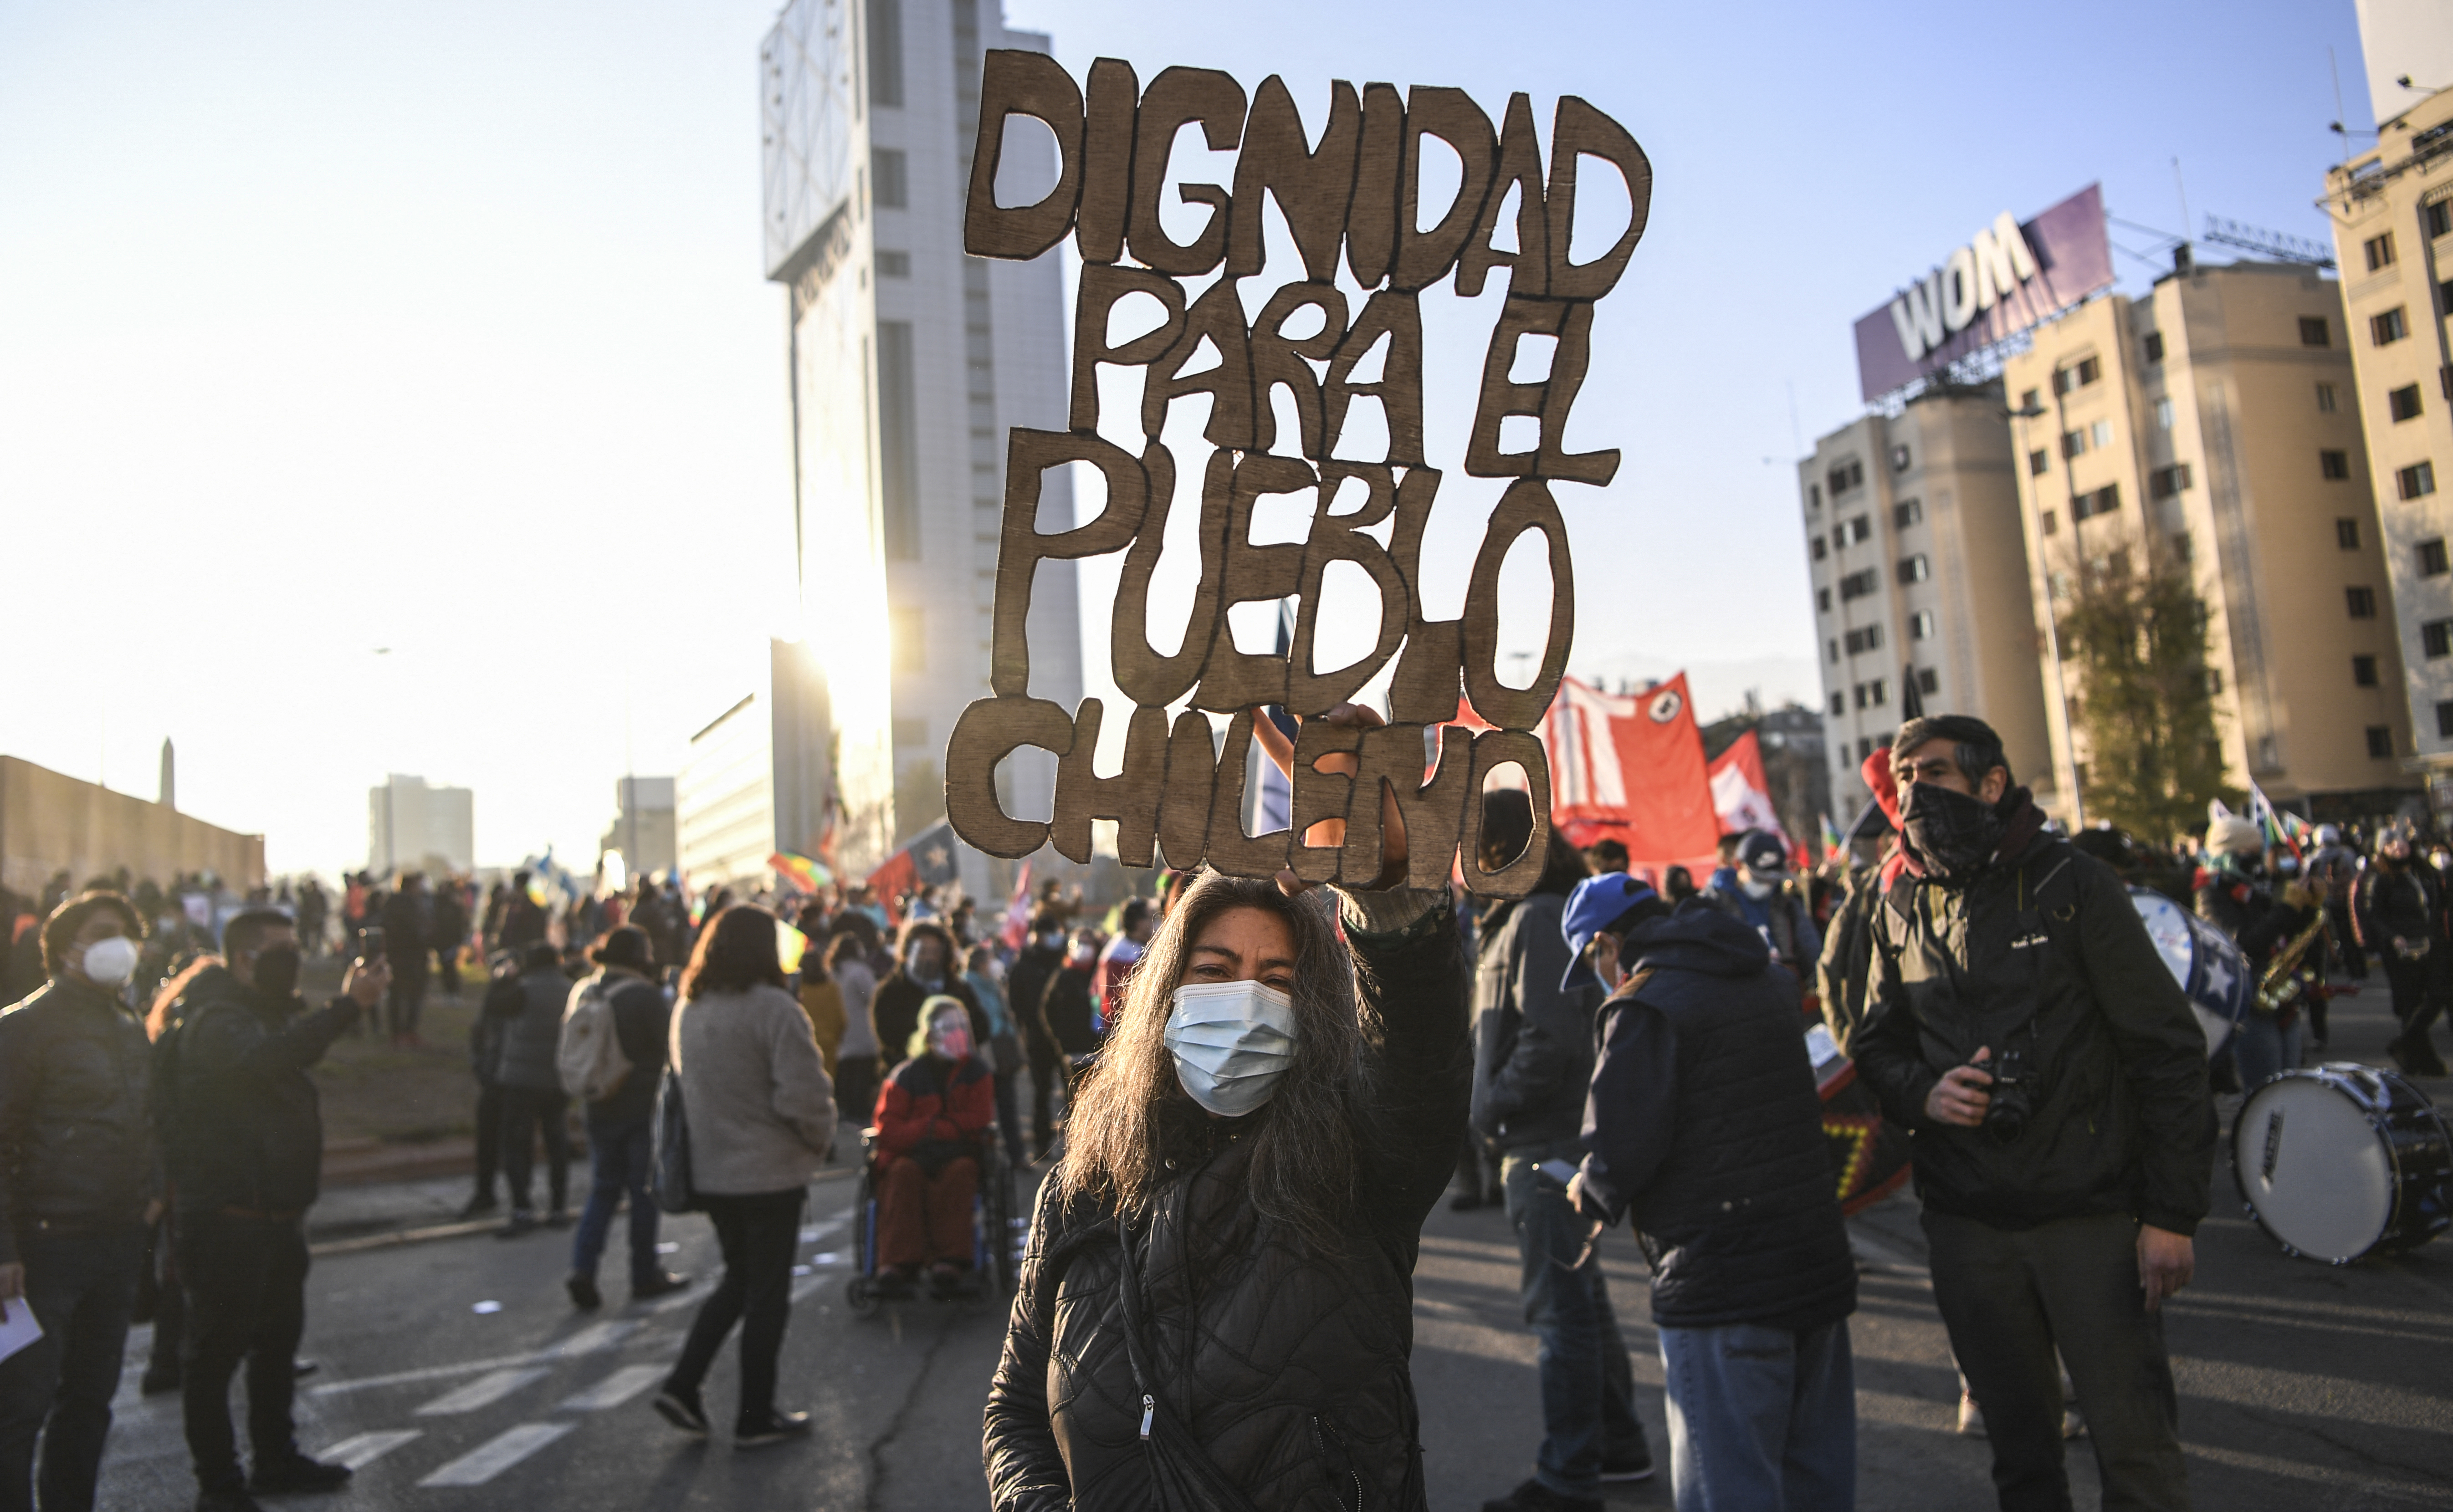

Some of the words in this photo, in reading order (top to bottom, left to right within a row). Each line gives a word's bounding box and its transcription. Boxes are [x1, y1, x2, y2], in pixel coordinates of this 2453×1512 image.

[964, 48, 1653, 301] DIGNIDAD
[1889, 210, 2036, 362] WOM
[1069, 261, 1426, 468] PARA
[1465, 296, 1621, 488] EL
[990, 426, 1575, 730] PUEBLO
[945, 695, 1551, 900] CHILENO
